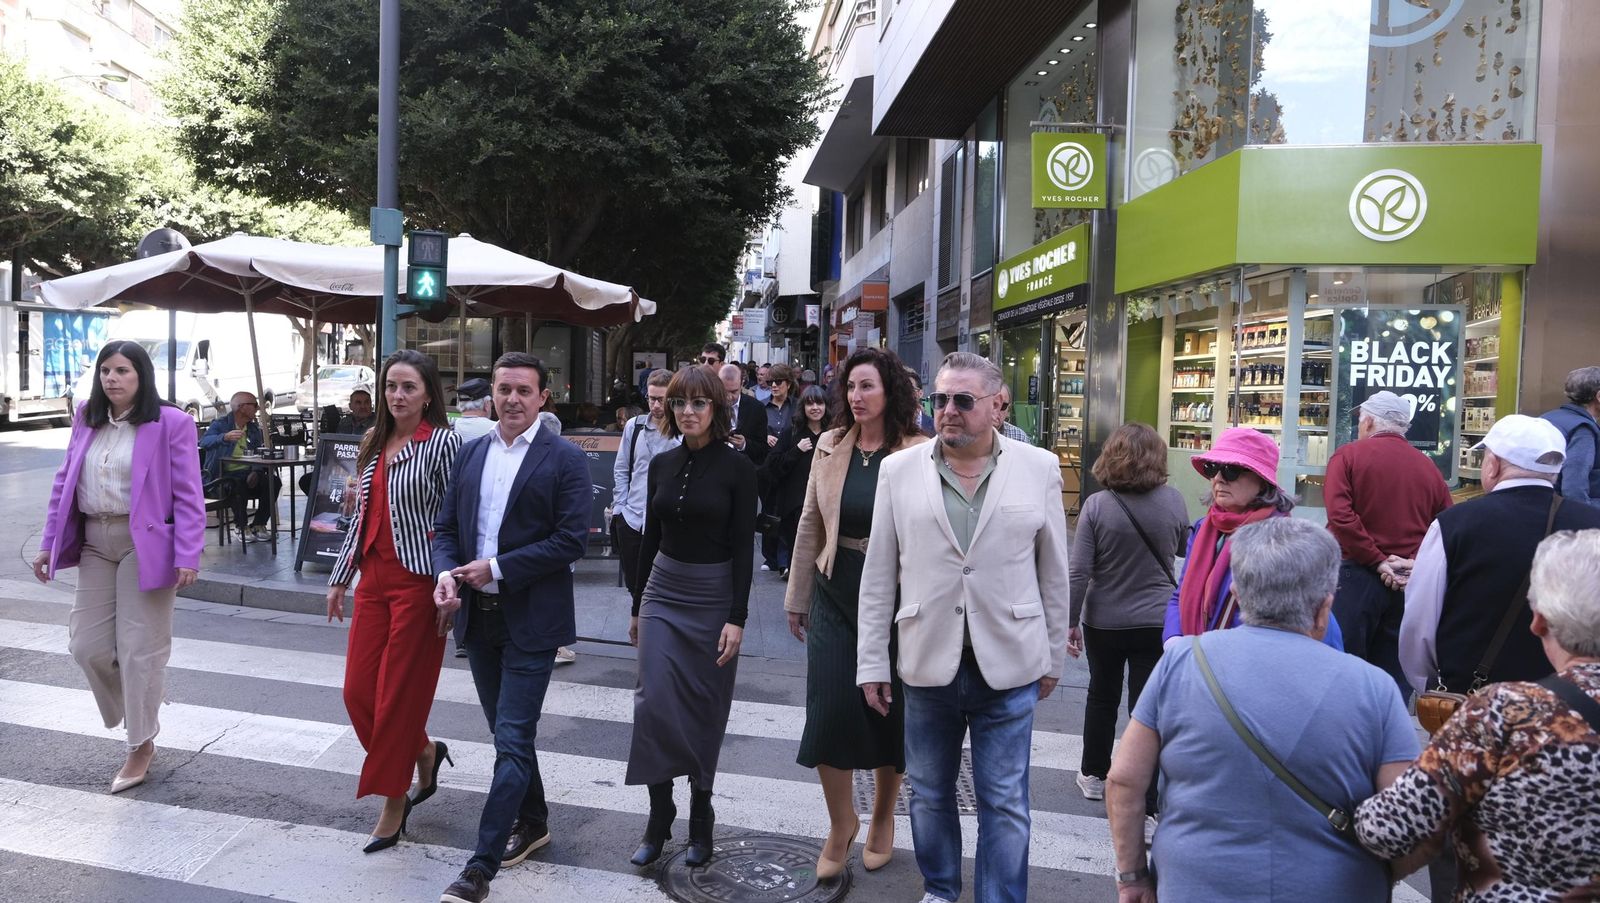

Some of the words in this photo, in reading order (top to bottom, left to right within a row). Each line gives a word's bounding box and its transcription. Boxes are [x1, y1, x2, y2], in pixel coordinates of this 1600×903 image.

[1064, 195, 1100, 203] ROCHER
[1009, 260, 1032, 285] YVES
[1032, 241, 1077, 275] ROCHER
[1026, 274, 1053, 293] FRANCE
[1350, 340, 1453, 365] BLACK
[1350, 364, 1452, 388] FRIDAY
[334, 443, 360, 452] PARRIL
